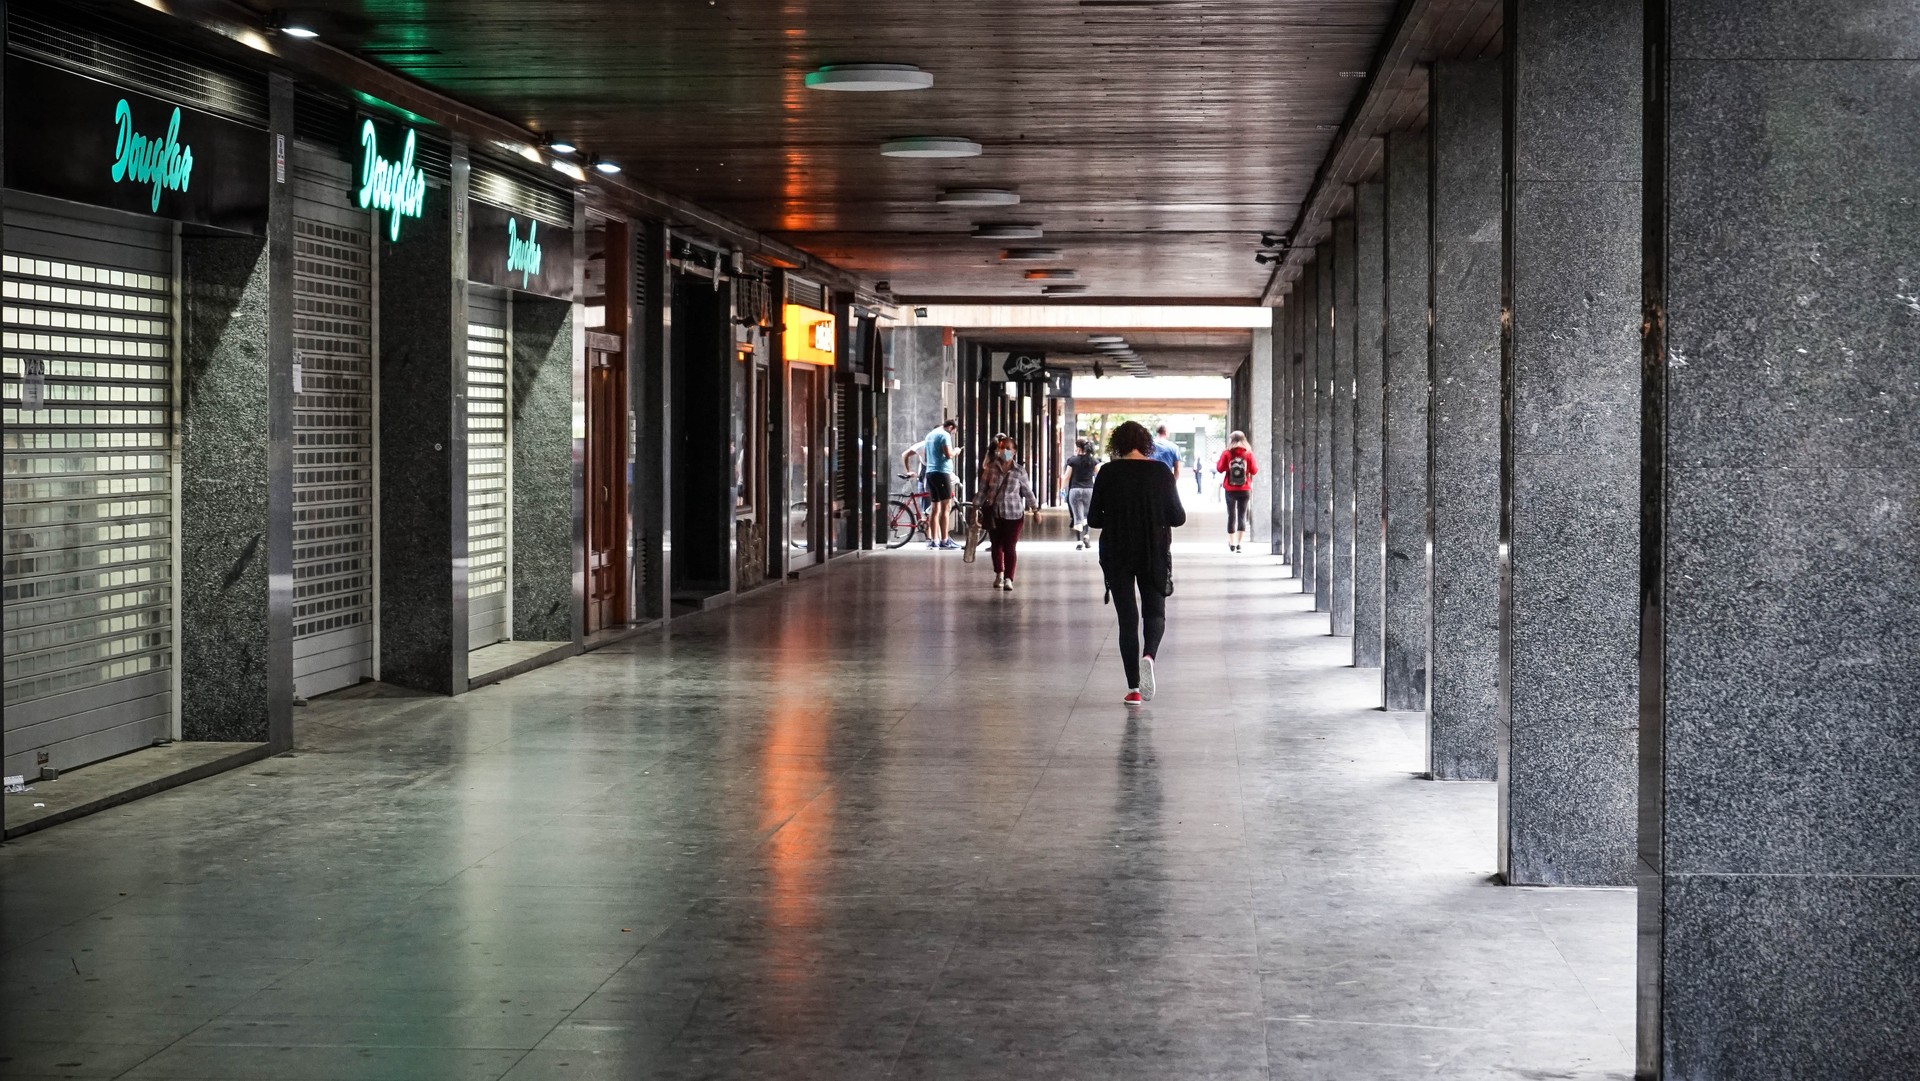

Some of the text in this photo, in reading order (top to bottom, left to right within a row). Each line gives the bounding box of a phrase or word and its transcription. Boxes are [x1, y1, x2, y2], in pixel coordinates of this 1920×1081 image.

[112, 99, 193, 213] Douglas
[360, 119, 426, 242] Douglas
[507, 217, 542, 290] Douglas
